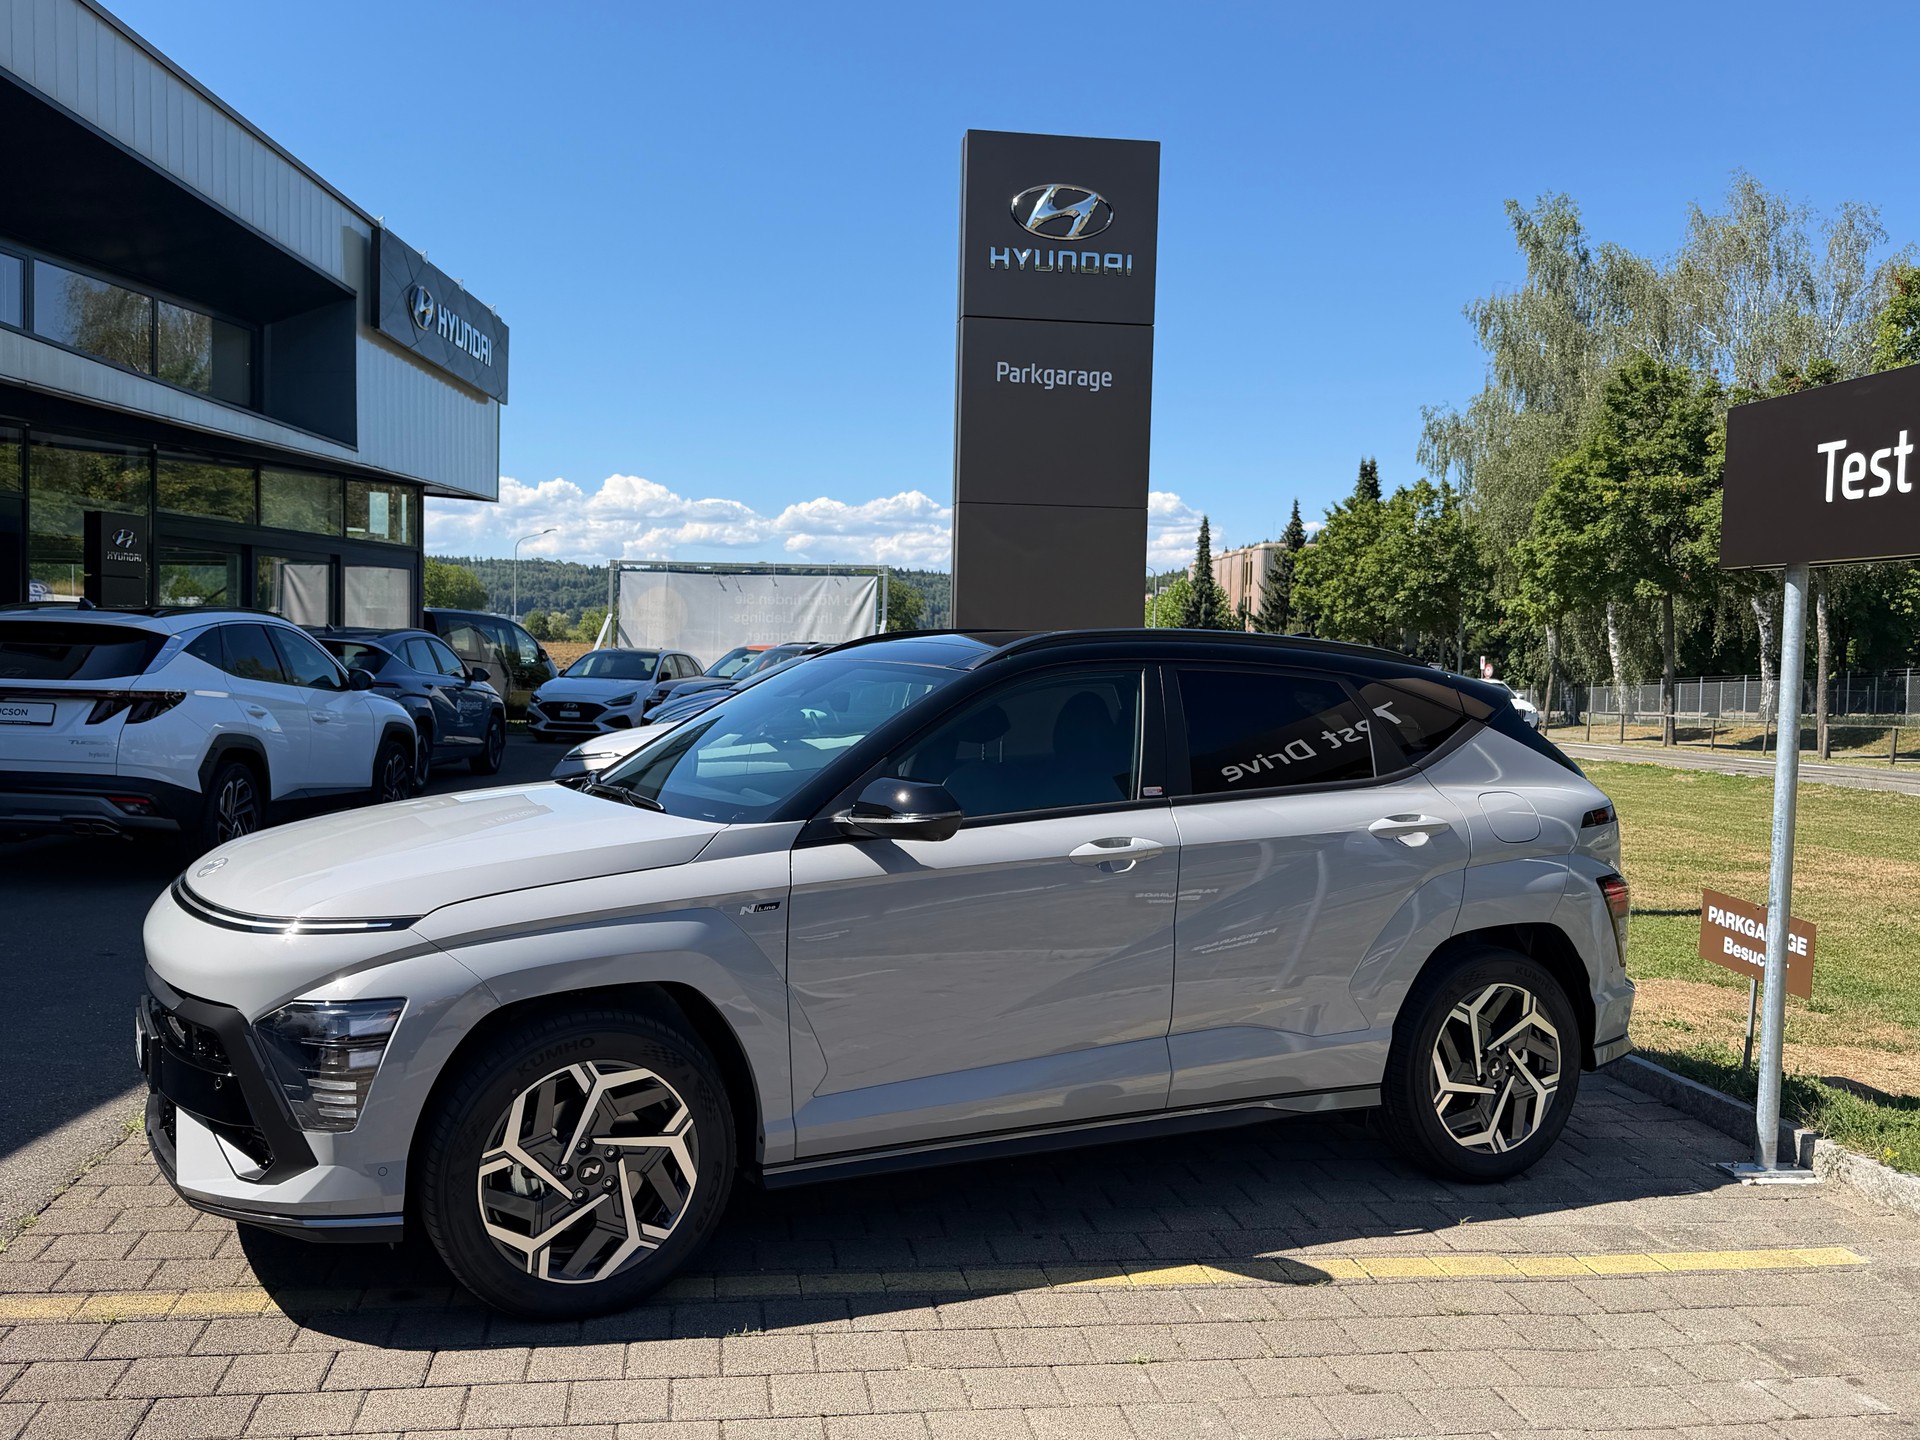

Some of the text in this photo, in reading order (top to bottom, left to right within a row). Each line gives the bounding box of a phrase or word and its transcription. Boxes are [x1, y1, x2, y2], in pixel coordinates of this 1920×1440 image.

[989, 246, 1133, 276] HYUNDAI
[437, 303, 492, 367] HYUNDAI
[996, 361, 1113, 392] Parkgarage
[1817, 429, 1914, 503] Test
[106, 551, 142, 562] HYUNDAI
[0, 708, 29, 717] CSON
[1707, 905, 1808, 956] PARKGAGE
[1723, 936, 1790, 969] Besuc
[515, 1037, 596, 1076] KUMHO
